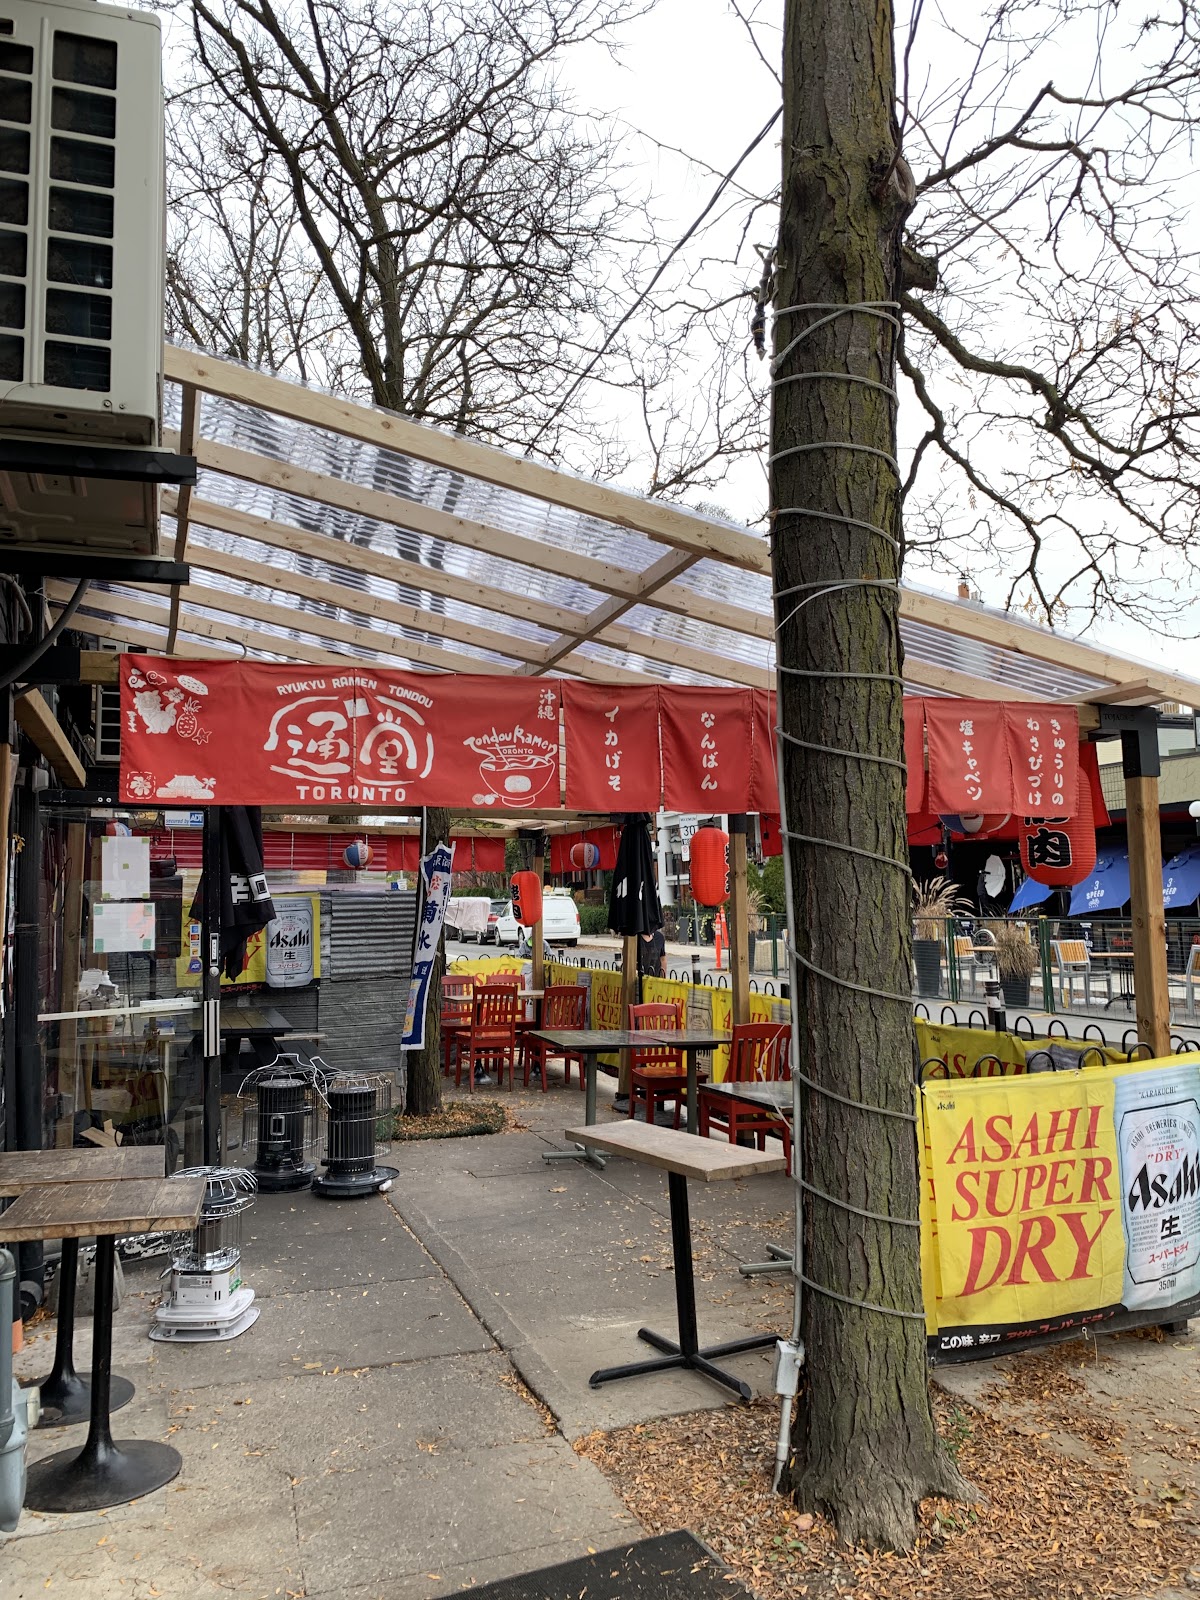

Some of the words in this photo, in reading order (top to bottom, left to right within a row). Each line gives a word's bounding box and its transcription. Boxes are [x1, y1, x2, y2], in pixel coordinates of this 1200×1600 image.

[276, 679, 326, 696] RYUKYU
[331, 676, 378, 690] RAMEN
[388, 684, 434, 709] TONDOU
[538, 688, 557, 721] 沖縄
[463, 727, 512, 747] Tondou
[514, 725, 557, 752] Ramen
[604, 705, 623, 792] イカげそ
[700, 711, 719, 790] なんばん
[959, 719, 983, 801] 塩キャベツ
[1026, 717, 1044, 806] わさびづけ
[296, 785, 406, 802] TORONTO
[190, 814, 203, 822] ADT
[684, 825, 696, 837] 30
[1086, 889, 1105, 900] SPEED
[1094, 880, 1100, 890] 3
[1162, 887, 1177, 896] PEED
[1167, 878, 1173, 888] 3
[269, 928, 310, 949] Asahi
[283, 951, 297, 961] 生
[946, 1105, 1105, 1165] ASAHI
[1130, 1130, 1145, 1150] ASAHI
[1145, 1118, 1178, 1134] BREWERIES
[951, 1156, 1113, 1222] SUPER
[1128, 1148, 1200, 1213] Asahi
[1160, 1214, 1182, 1240] 生
[955, 1208, 1116, 1298] DRY
[1148, 1241, 1189, 1264] スーパードライ
[1158, 1277, 1177, 1291] 350ml
